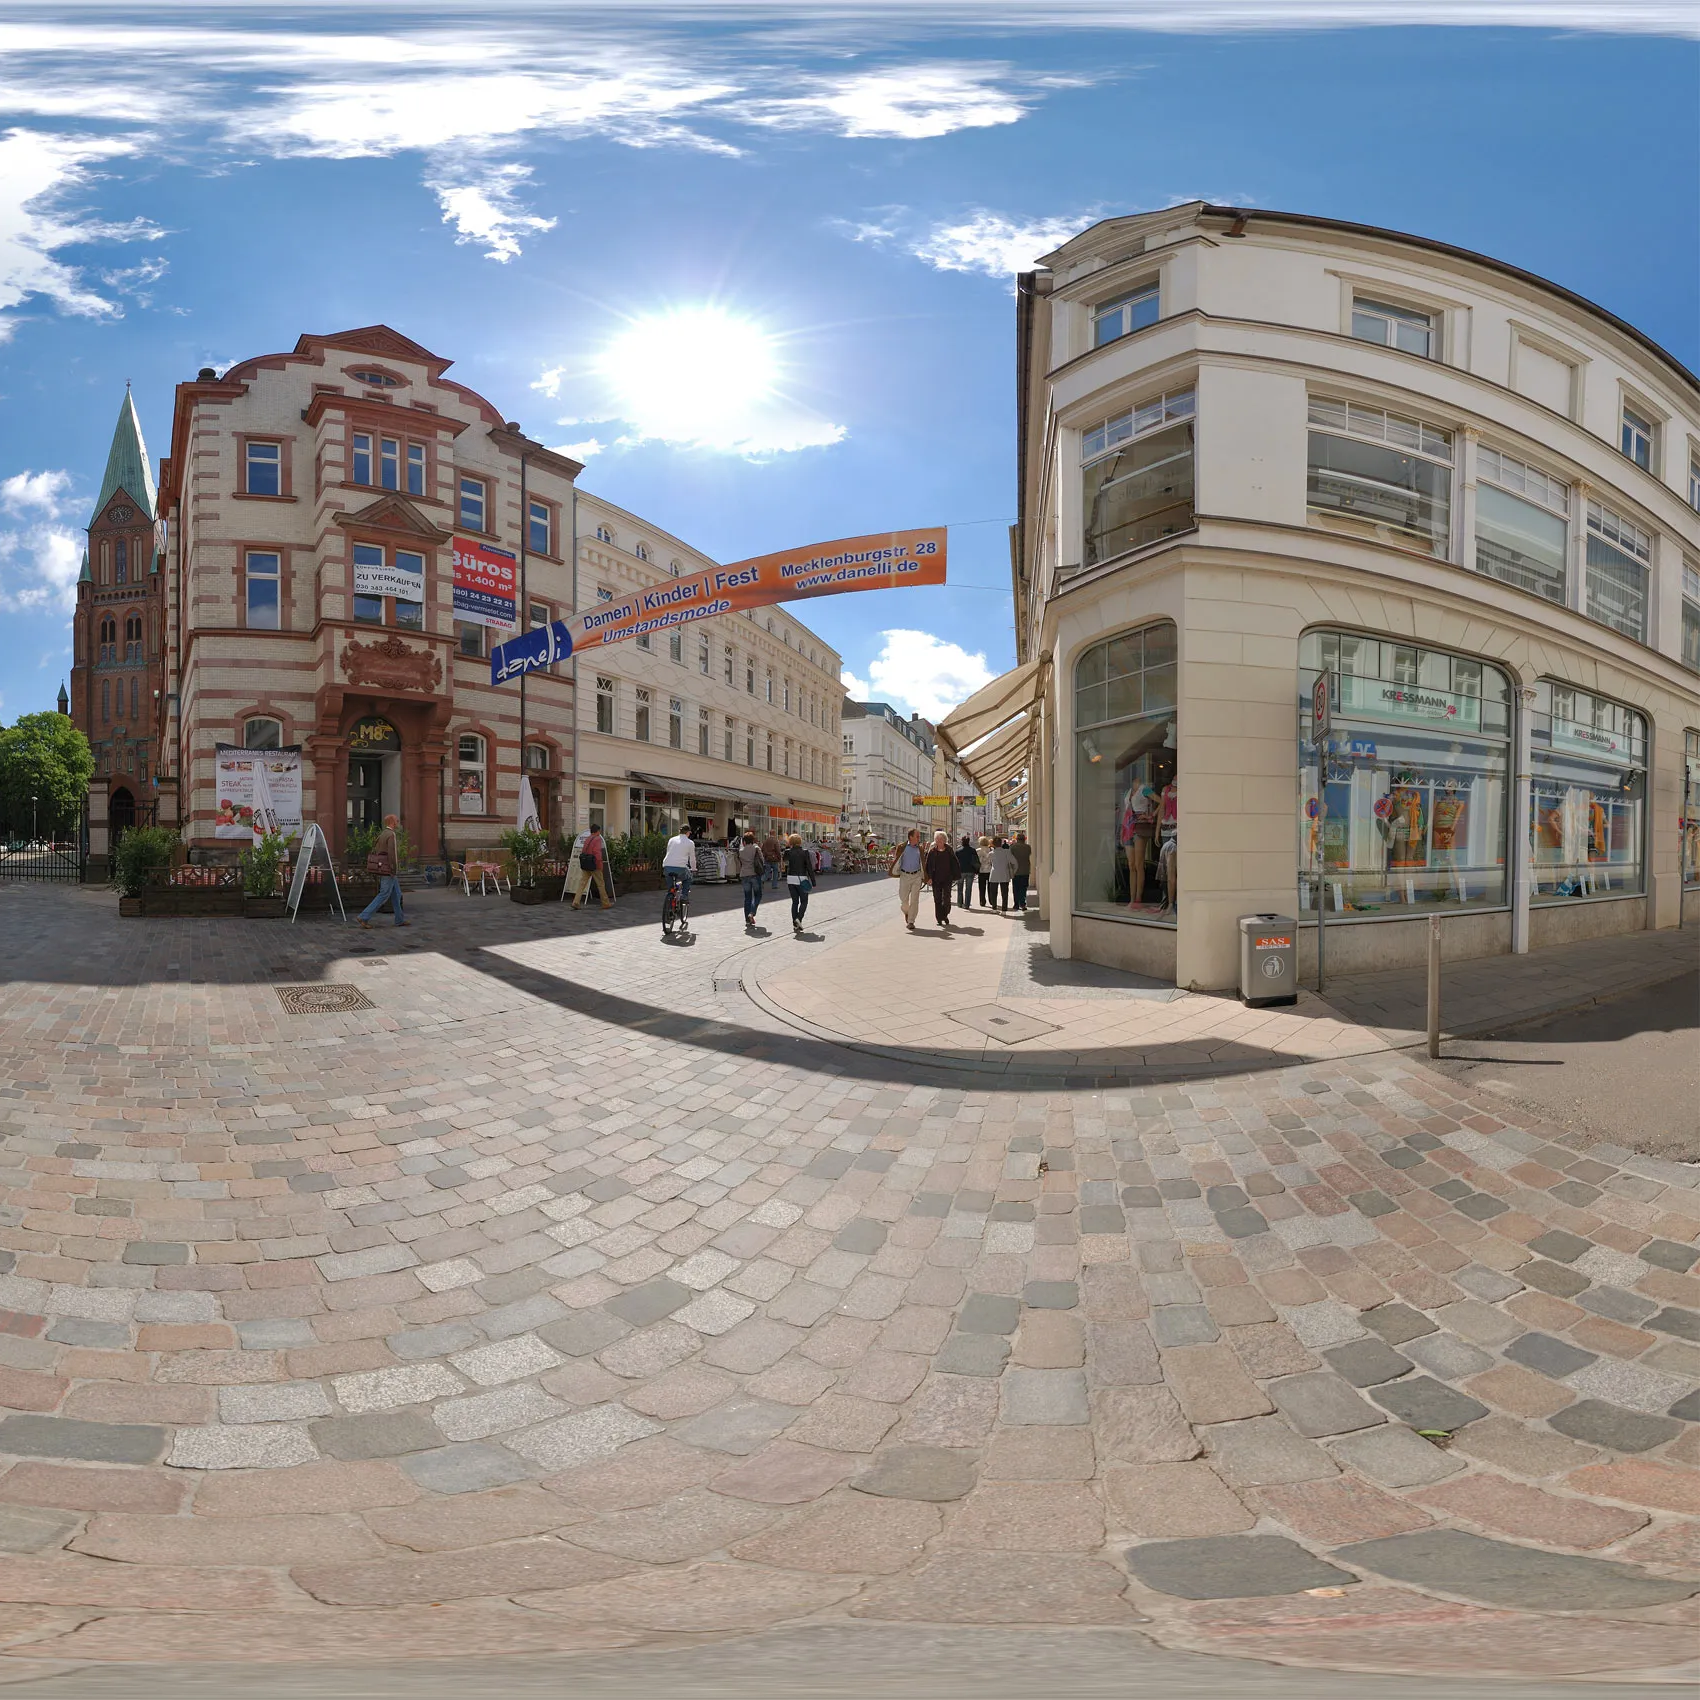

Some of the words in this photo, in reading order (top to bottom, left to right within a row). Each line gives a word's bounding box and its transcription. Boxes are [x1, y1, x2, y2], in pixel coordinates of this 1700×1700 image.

[781, 546, 909, 577] Mecklenburgstr.
[915, 542, 936, 555] 28
[356, 573, 369, 581] ZU
[371, 574, 421, 589] VERKAUFEN
[466, 573, 495, 588] 1.400
[796, 560, 919, 589] www.danelli.de
[470, 592, 480, 600] 24
[583, 604, 631, 630] Damen
[643, 583, 699, 610] Kinder
[715, 566, 759, 590] Fest
[485, 617, 513, 629] STRABAG
[602, 599, 730, 643] Umstandsmode
[496, 623, 561, 680] danelli
[1382, 688, 1447, 709] KRESSMANN
[1574, 728, 1611, 745] KRESSMANN
[221, 780, 241, 788] STEAK
[1261, 937, 1285, 946] SAS
